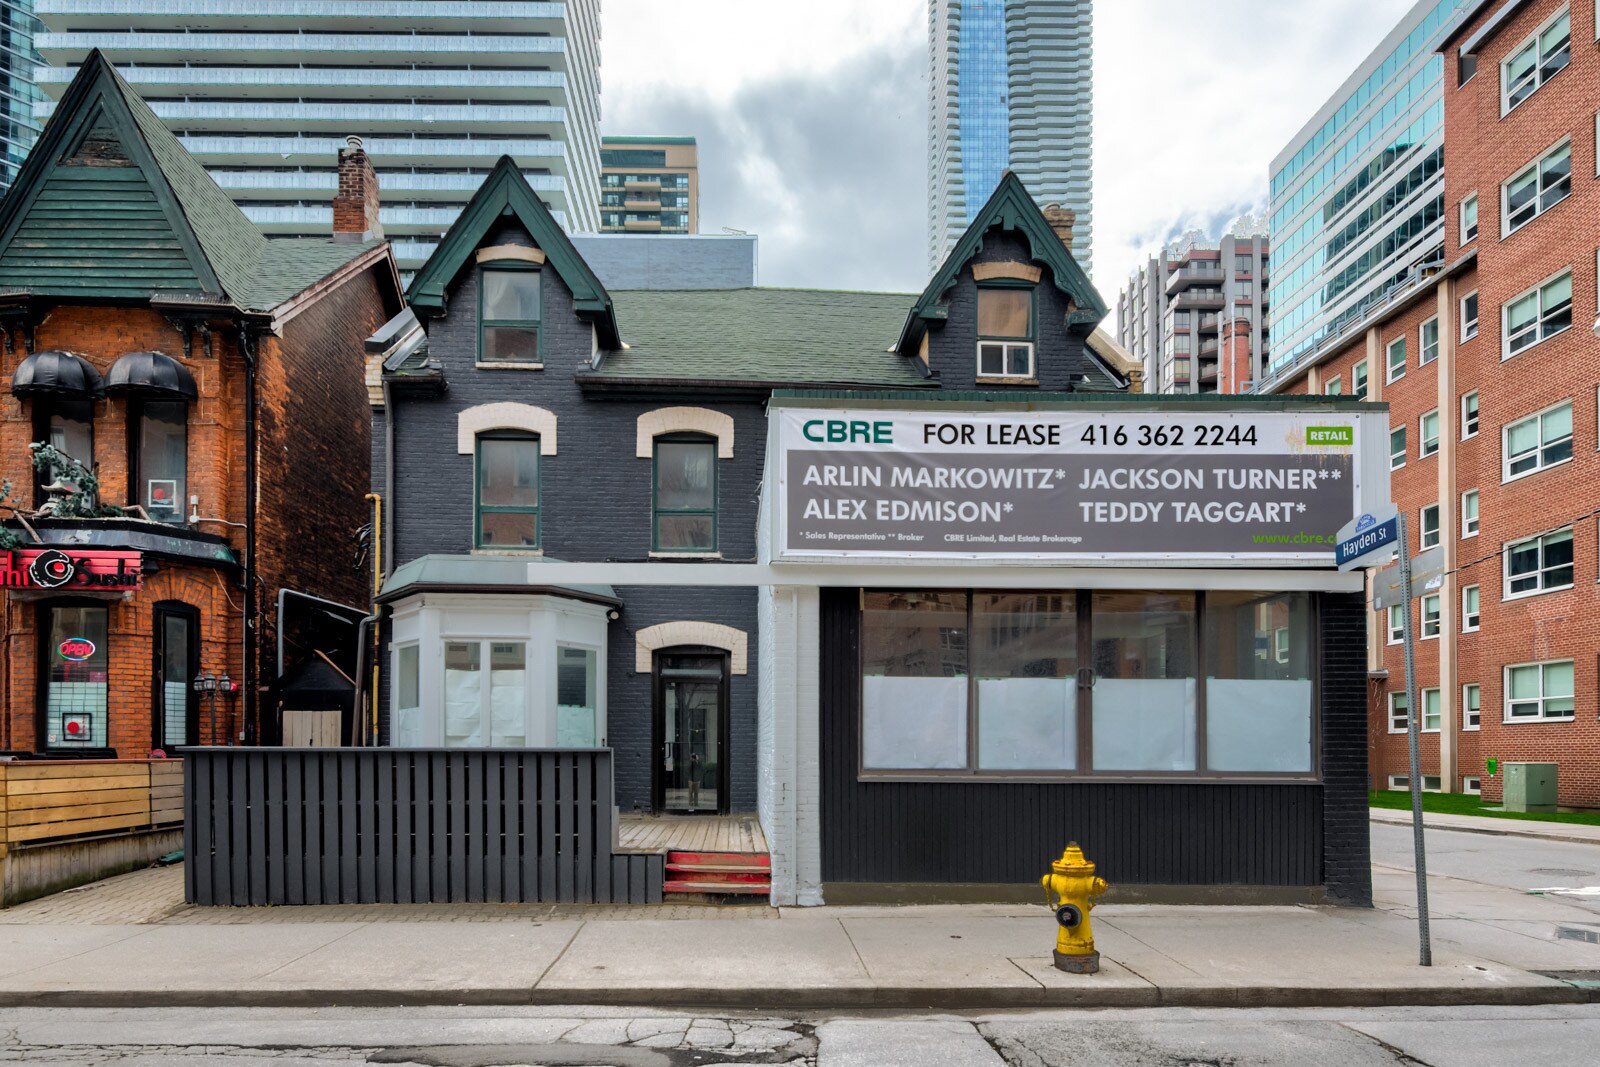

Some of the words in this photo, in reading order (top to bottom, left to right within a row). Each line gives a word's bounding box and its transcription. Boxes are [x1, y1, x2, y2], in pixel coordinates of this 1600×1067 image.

[802, 420, 894, 443] CBRE
[923, 424, 975, 445] FOR
[986, 425, 1060, 446] LEASE
[1080, 425, 1128, 446] 416
[1137, 426, 1184, 446] 362
[1193, 426, 1258, 446] 2244
[1310, 432, 1349, 441] RETAIL
[803, 465, 882, 487] ARLIN
[1078, 468, 1204, 491] JACKSON
[803, 499, 867, 520] ALEX
[1079, 502, 1164, 523] TEDDY
[805, 532, 826, 540] Sales
[828, 532, 886, 542] Representative
[897, 533, 925, 541] Broker
[944, 534, 965, 542] CBRE
[966, 534, 997, 543] Limited,
[998, 534, 1016, 543] Real
[1017, 535, 1041, 543] Estate
[1042, 535, 1083, 544] Brokerage
[1342, 532, 1377, 558] Hayden
[1378, 527, 1387, 541] St
[74, 557, 139, 587] Sushi
[60, 643, 92, 656] OPEN
